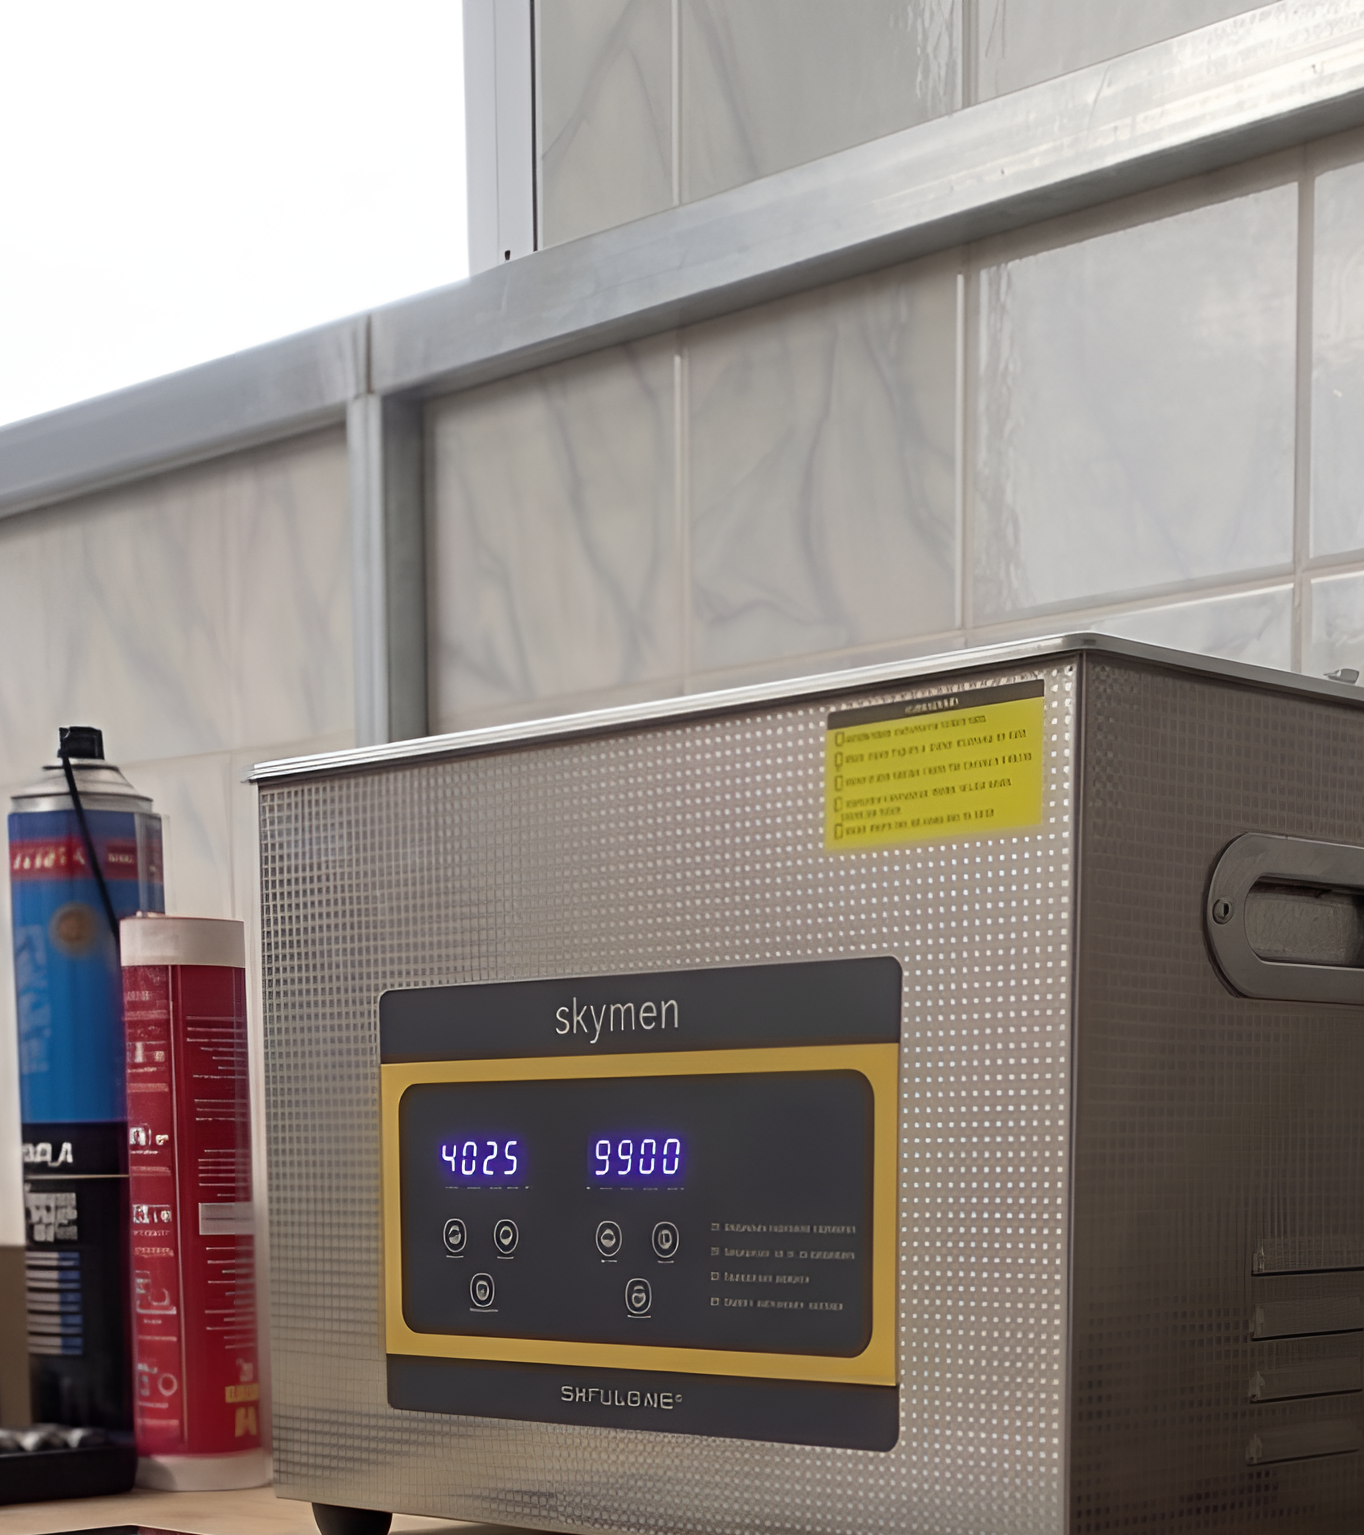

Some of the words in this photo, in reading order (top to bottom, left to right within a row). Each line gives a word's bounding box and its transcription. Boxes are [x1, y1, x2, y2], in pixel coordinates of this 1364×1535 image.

[555, 996, 678, 1044] skymen
[442, 1141, 517, 1175] 4025
[595, 1138, 680, 1175] 9900
